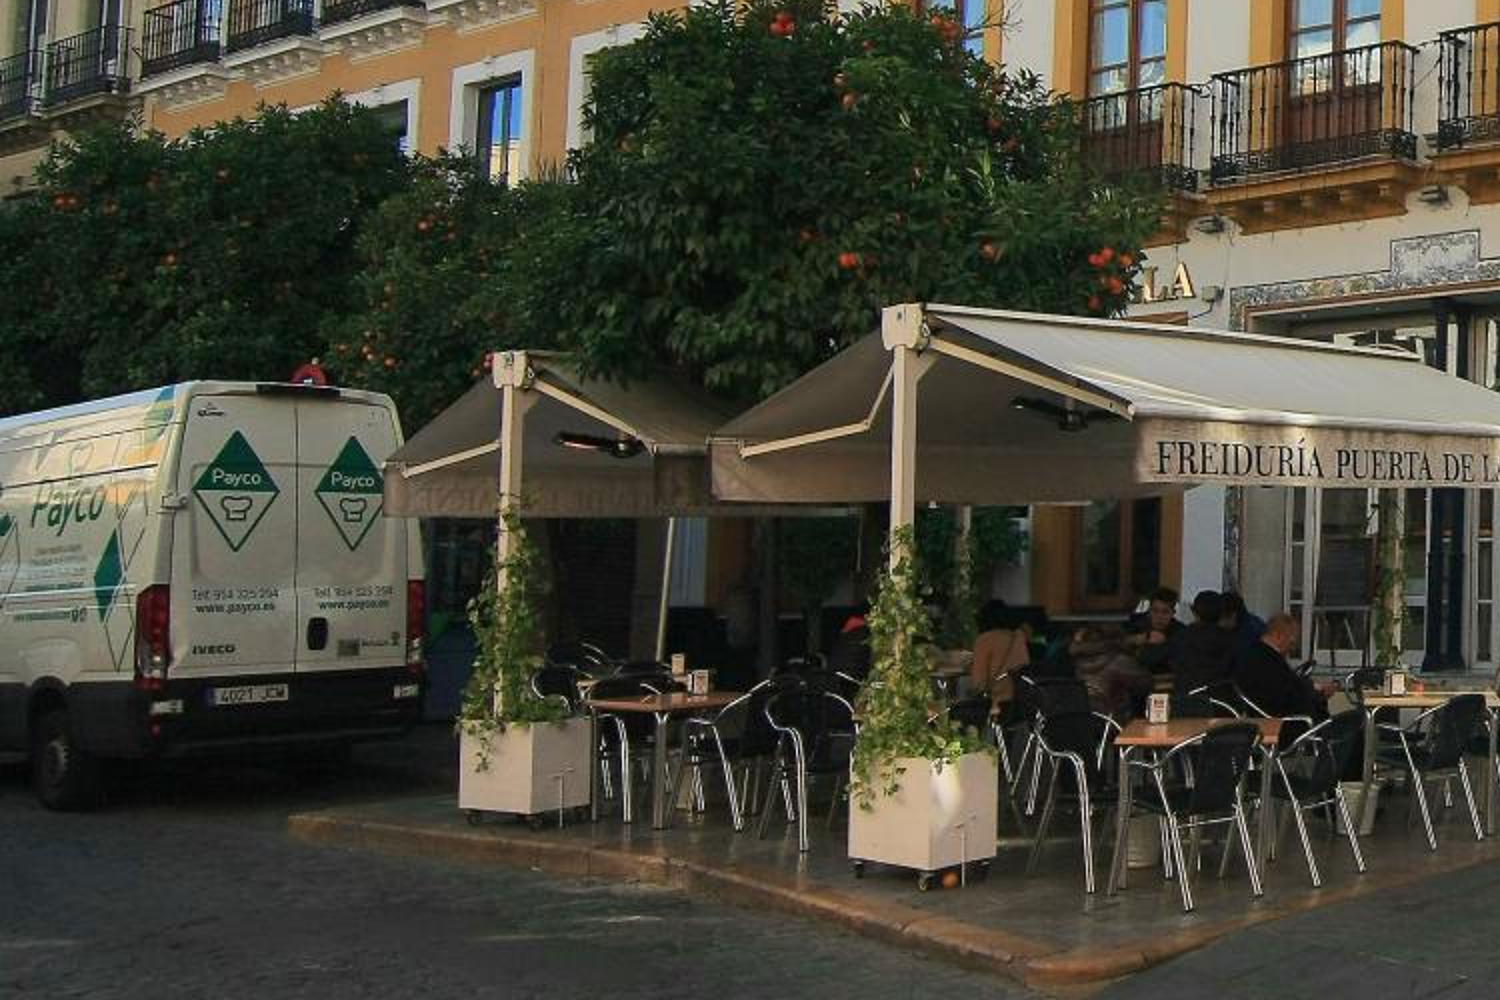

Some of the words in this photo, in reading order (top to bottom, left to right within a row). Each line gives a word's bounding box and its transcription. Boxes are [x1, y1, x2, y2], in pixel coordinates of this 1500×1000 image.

[1155, 437, 1325, 479] FREIDURÍA
[1336, 448, 1432, 482] PUERTA
[1443, 452, 1475, 483] DE
[211, 467, 261, 487] Payco
[330, 471, 375, 490] Payco
[30, 484, 107, 537] Payco
[191, 643, 237, 655] IVECO
